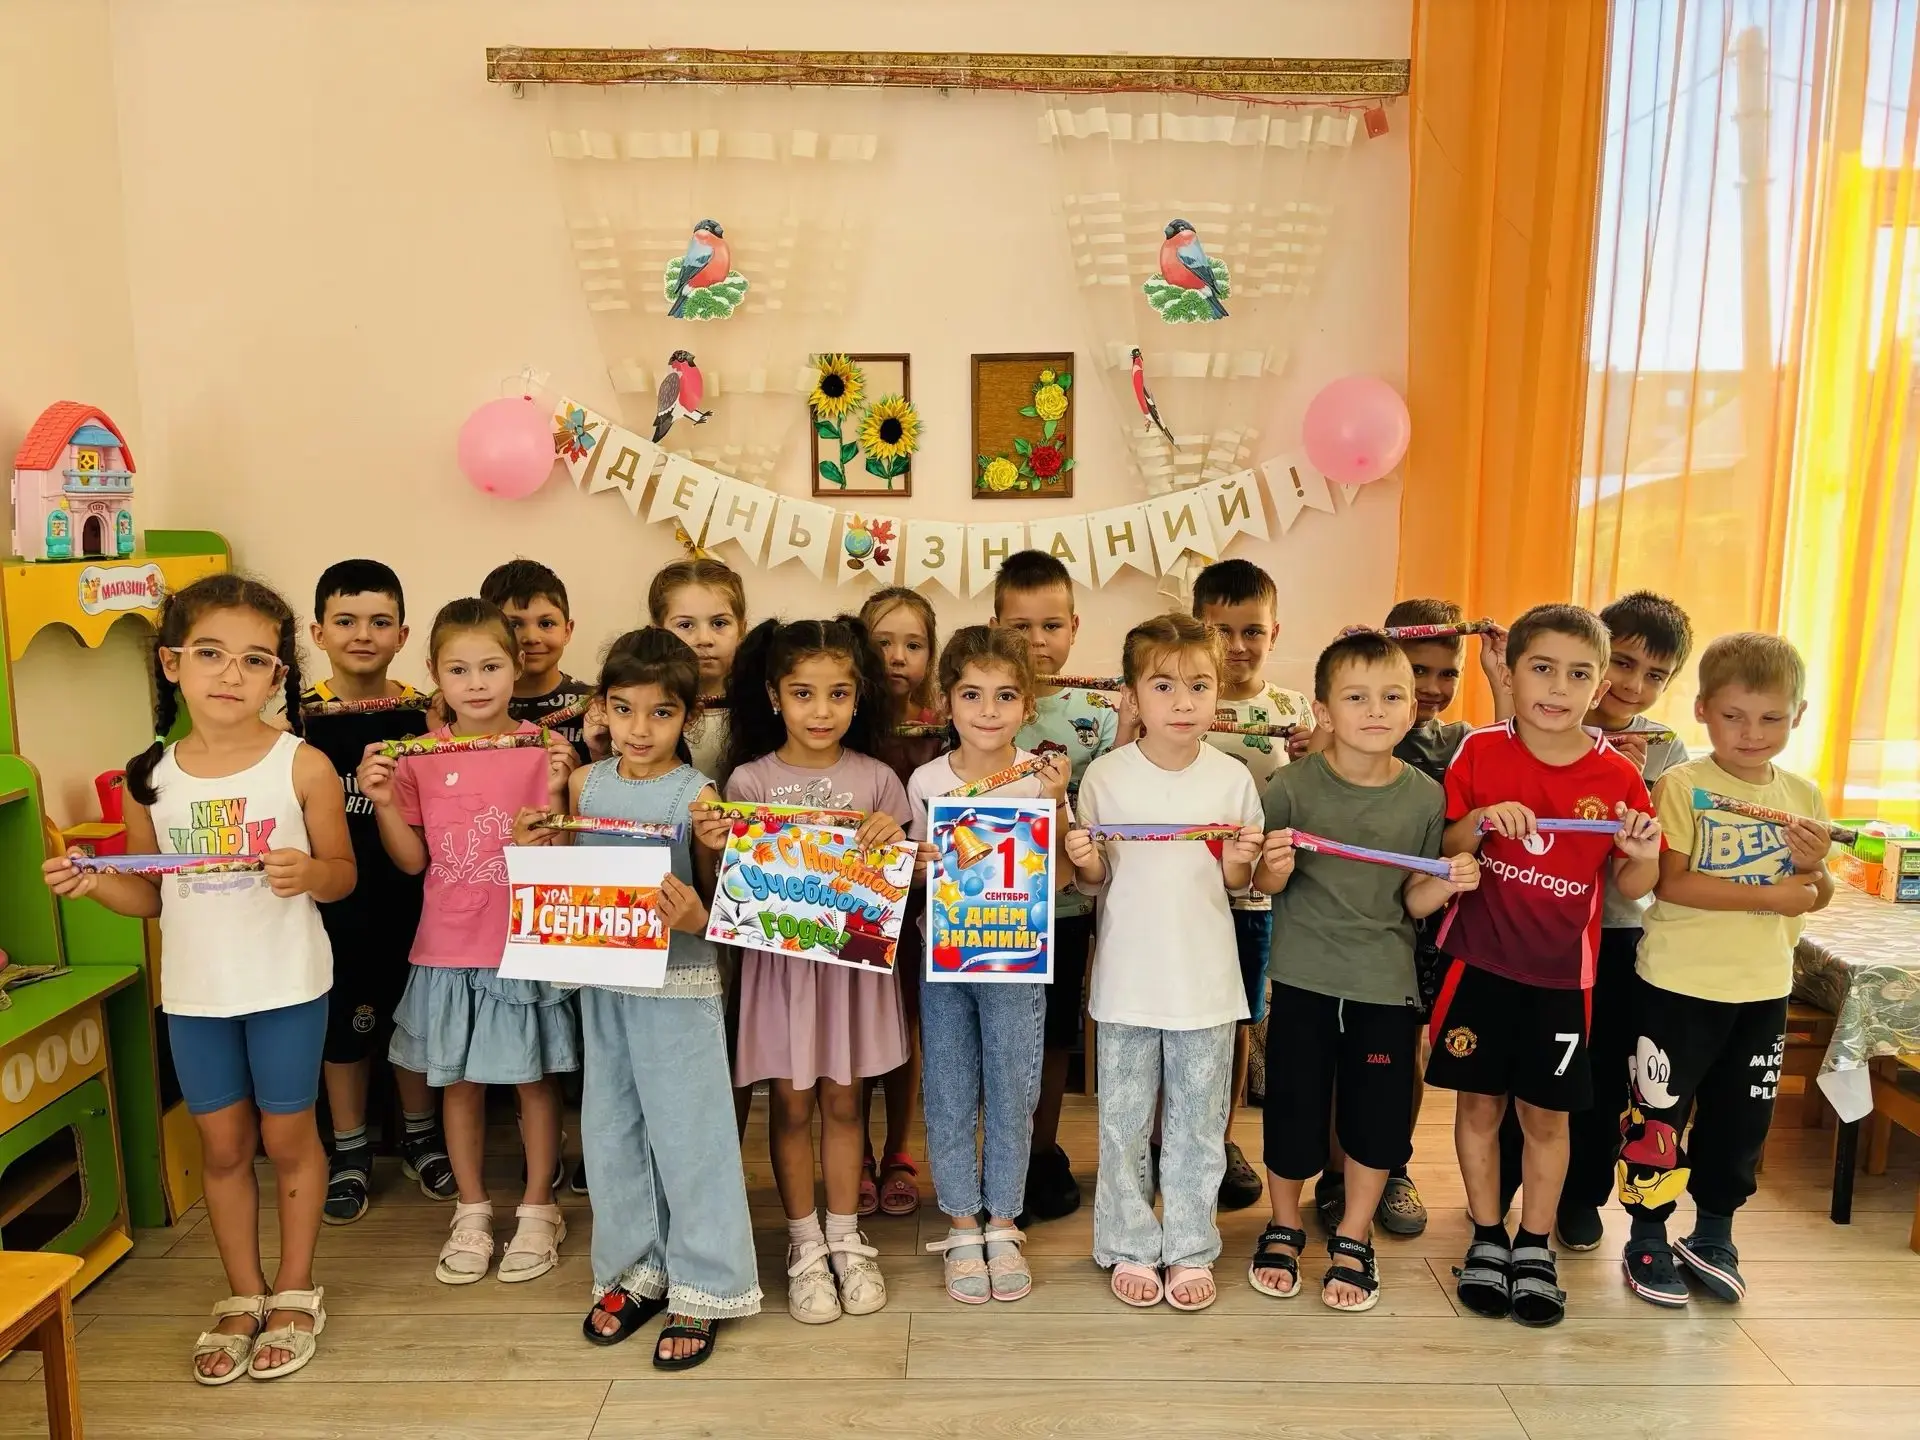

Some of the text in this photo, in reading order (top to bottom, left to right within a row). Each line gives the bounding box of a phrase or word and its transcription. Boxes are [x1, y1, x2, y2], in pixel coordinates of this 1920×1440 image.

[605, 446, 812, 549] ДЕНЬ
[102, 580, 146, 600] МАГАЗИН
[191, 797, 247, 829] NEW
[169, 818, 276, 855] YORK
[777, 835, 799, 868] С
[1710, 823, 1788, 866] BEA
[998, 837, 1015, 889] 1
[542, 887, 573, 903] УРА!
[739, 864, 882, 922] Учебного
[985, 891, 1029, 902] СЕНТЯБРЯ
[515, 886, 663, 939] 1 СЕНТЯБРЯ
[948, 904, 1028, 929] С ДНЁМ
[939, 925, 1038, 949] ЗНАНИЙ!
[1367, 1054, 1391, 1064] ZARA
[1554, 1033, 1579, 1076] 7
[1749, 1054, 1784, 1067] MIC
